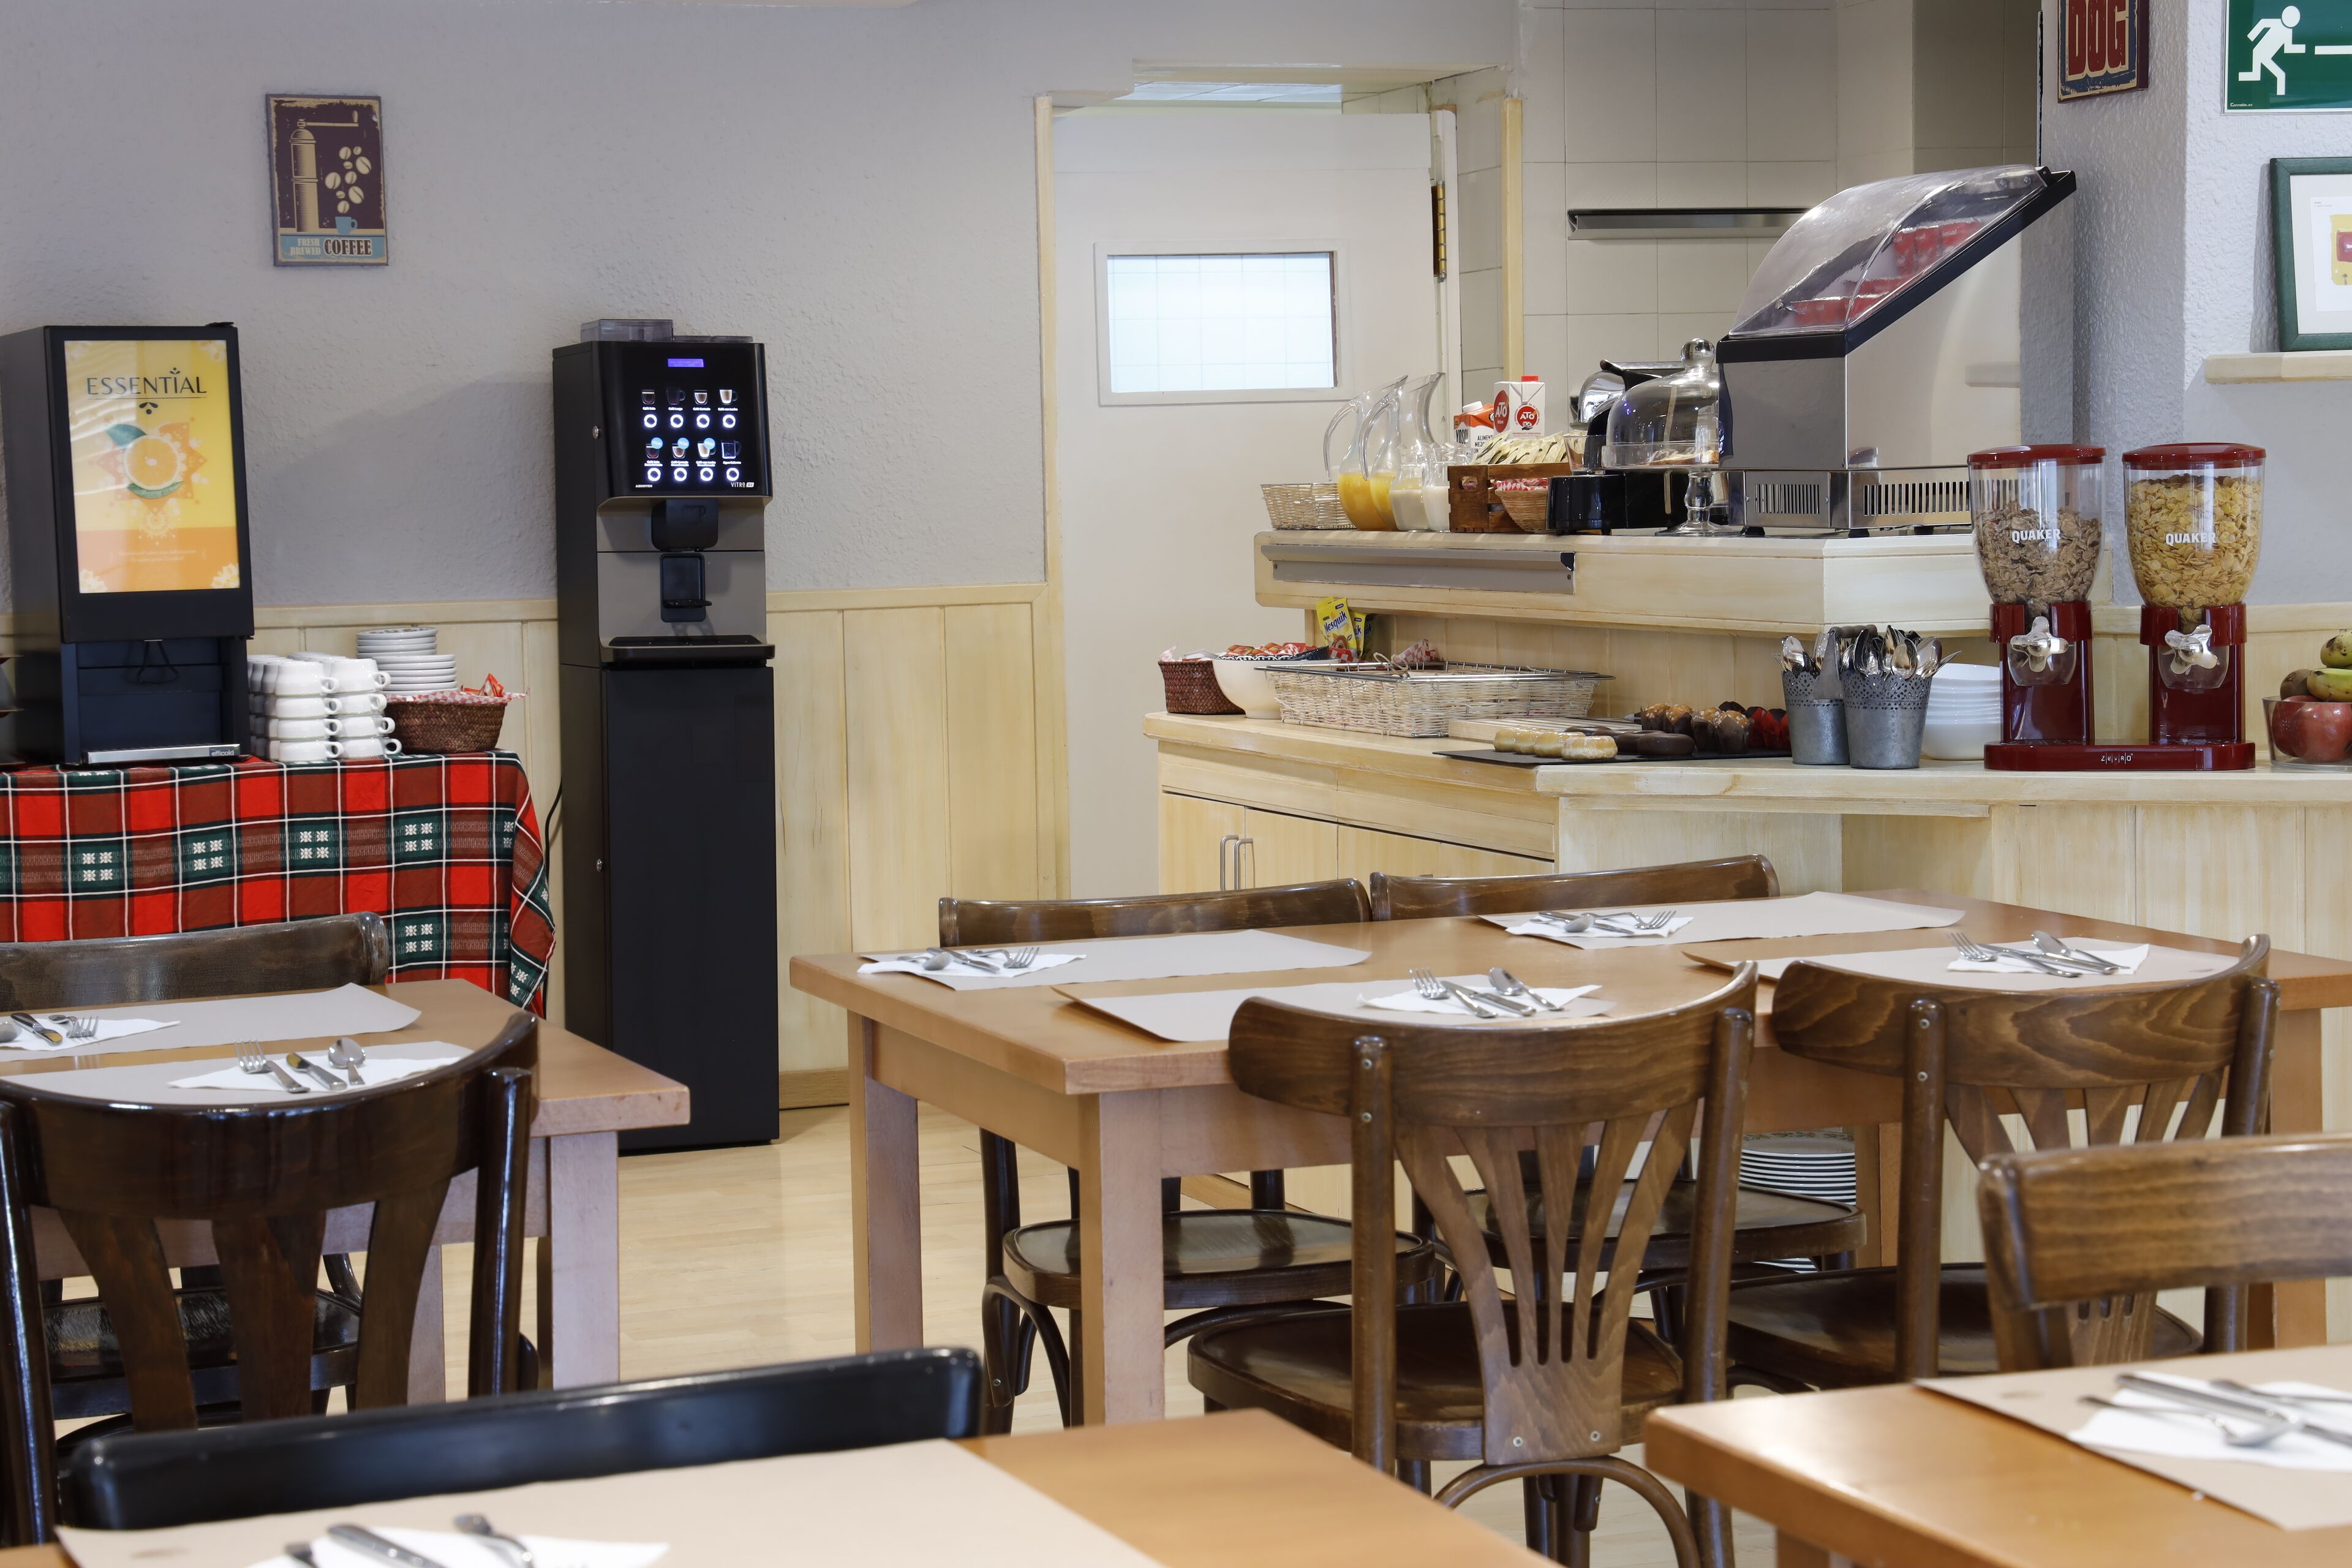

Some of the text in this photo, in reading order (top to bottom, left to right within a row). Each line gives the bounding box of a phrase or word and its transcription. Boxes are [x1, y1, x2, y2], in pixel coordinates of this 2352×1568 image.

[2067, 0, 2127, 76] DOG
[290, 247, 321, 255] BREWED
[324, 238, 372, 255] COFFEE
[86, 372, 207, 396] ESSENTIAL
[1494, 402, 1507, 418] ATO
[1519, 412, 1535, 420] ATO
[2011, 529, 2061, 544] QUAKER
[2165, 532, 2217, 547] QUAKER
[1324, 610, 1348, 633] Nesquik
